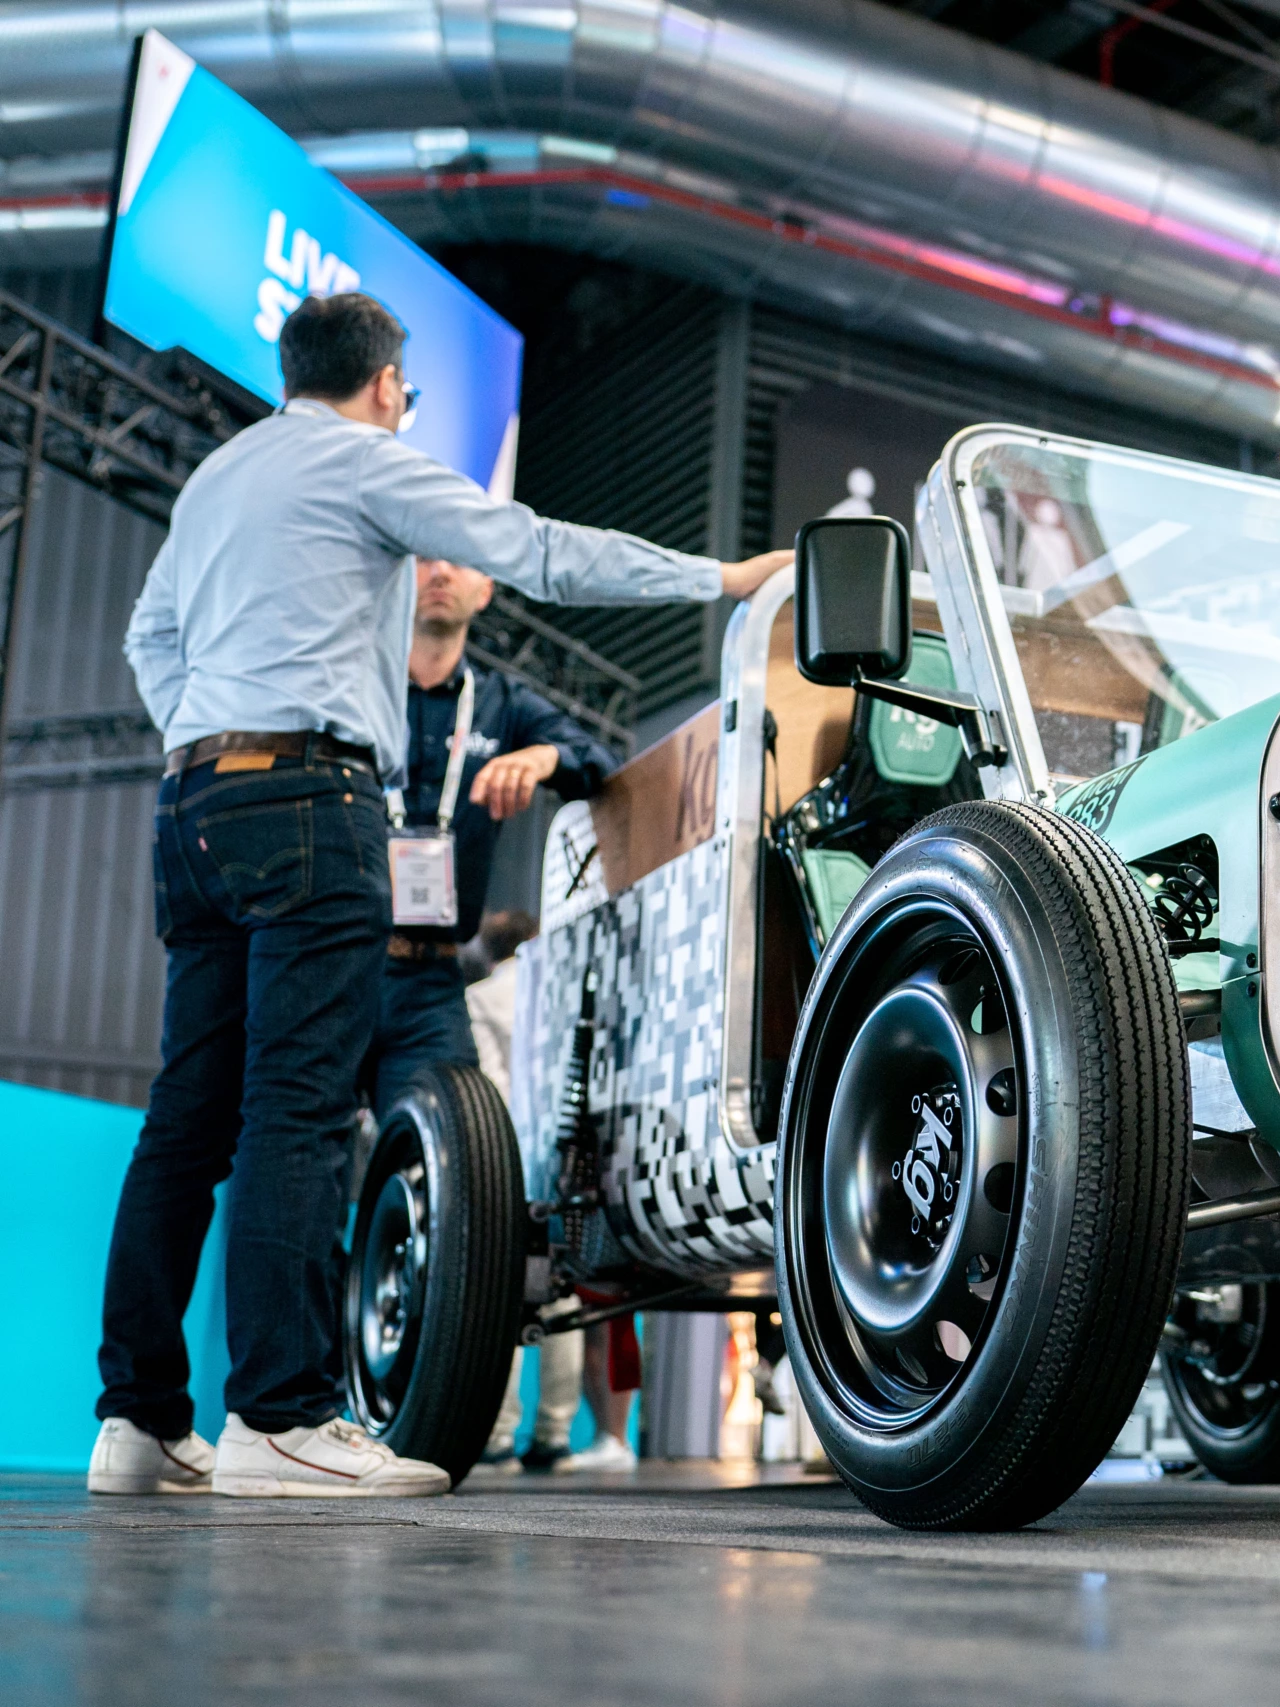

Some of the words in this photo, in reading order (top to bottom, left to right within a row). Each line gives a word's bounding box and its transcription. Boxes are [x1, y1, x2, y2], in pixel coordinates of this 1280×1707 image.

[897, 732, 936, 752] AUTO
[1076, 763, 1137, 804] MCM
[902, 1102, 953, 1222] kg
[1001, 1135, 1047, 1334] SHINKO
[907, 1397, 970, 1468] E-270
